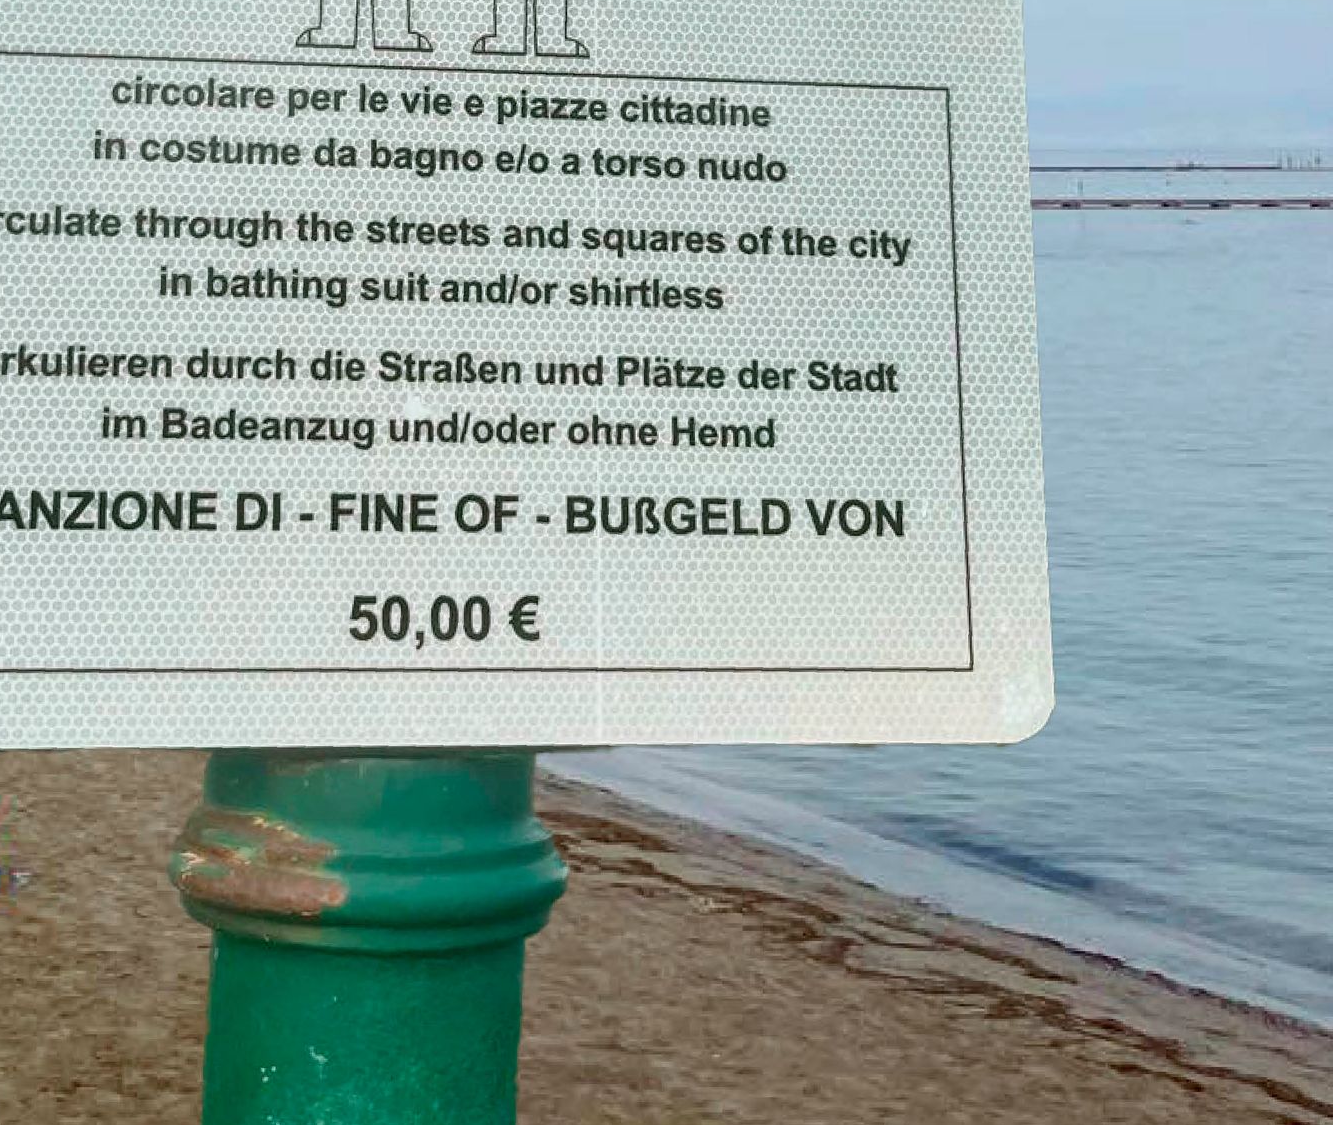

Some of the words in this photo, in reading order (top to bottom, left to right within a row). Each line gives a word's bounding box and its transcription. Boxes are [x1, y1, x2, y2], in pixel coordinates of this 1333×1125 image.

[112, 78, 274, 108] circolare
[289, 89, 347, 117] per
[360, 83, 388, 112] le
[401, 86, 452, 116] vie
[464, 94, 484, 116] e
[498, 90, 608, 124] piazze
[620, 94, 770, 127] cittadine
[94, 130, 127, 161] in
[140, 136, 300, 166] costume
[314, 138, 357, 167] da
[371, 140, 483, 178] bagno
[495, 144, 549, 173] e/o
[562, 153, 580, 175] a
[592, 148, 685, 178] torso
[699, 153, 787, 182] nudo
[135, 208, 283, 248] through
[297, 212, 353, 242] the
[367, 216, 490, 247] streets
[504, 219, 568, 249] and
[582, 227, 725, 258] squares
[738, 226, 773, 254] of
[782, 228, 837, 257] the
[849, 230, 911, 266] city
[160, 266, 191, 296] in
[207, 267, 347, 308] bathing
[361, 272, 429, 301] suit
[440, 274, 558, 305] and/or
[570, 277, 723, 309] shirtless
[187, 348, 296, 380] durch
[311, 350, 365, 381] die
[379, 351, 521, 384] Straßen
[536, 356, 603, 386] und
[617, 356, 725, 389] Plätze
[738, 360, 796, 390] der
[808, 361, 898, 393] Stadt
[103, 407, 146, 439] im
[162, 408, 374, 450] Badeanzug
[390, 412, 556, 444] und/oder
[568, 415, 657, 446] ohne
[672, 416, 775, 448] Hemd
[236, 492, 281, 531] DI
[330, 493, 438, 532] FINE
[455, 495, 519, 533] OF
[567, 496, 791, 536] BUßGELD
[806, 499, 904, 537] VON
[350, 595, 490, 649] 50,00
[509, 596, 539, 641] €
